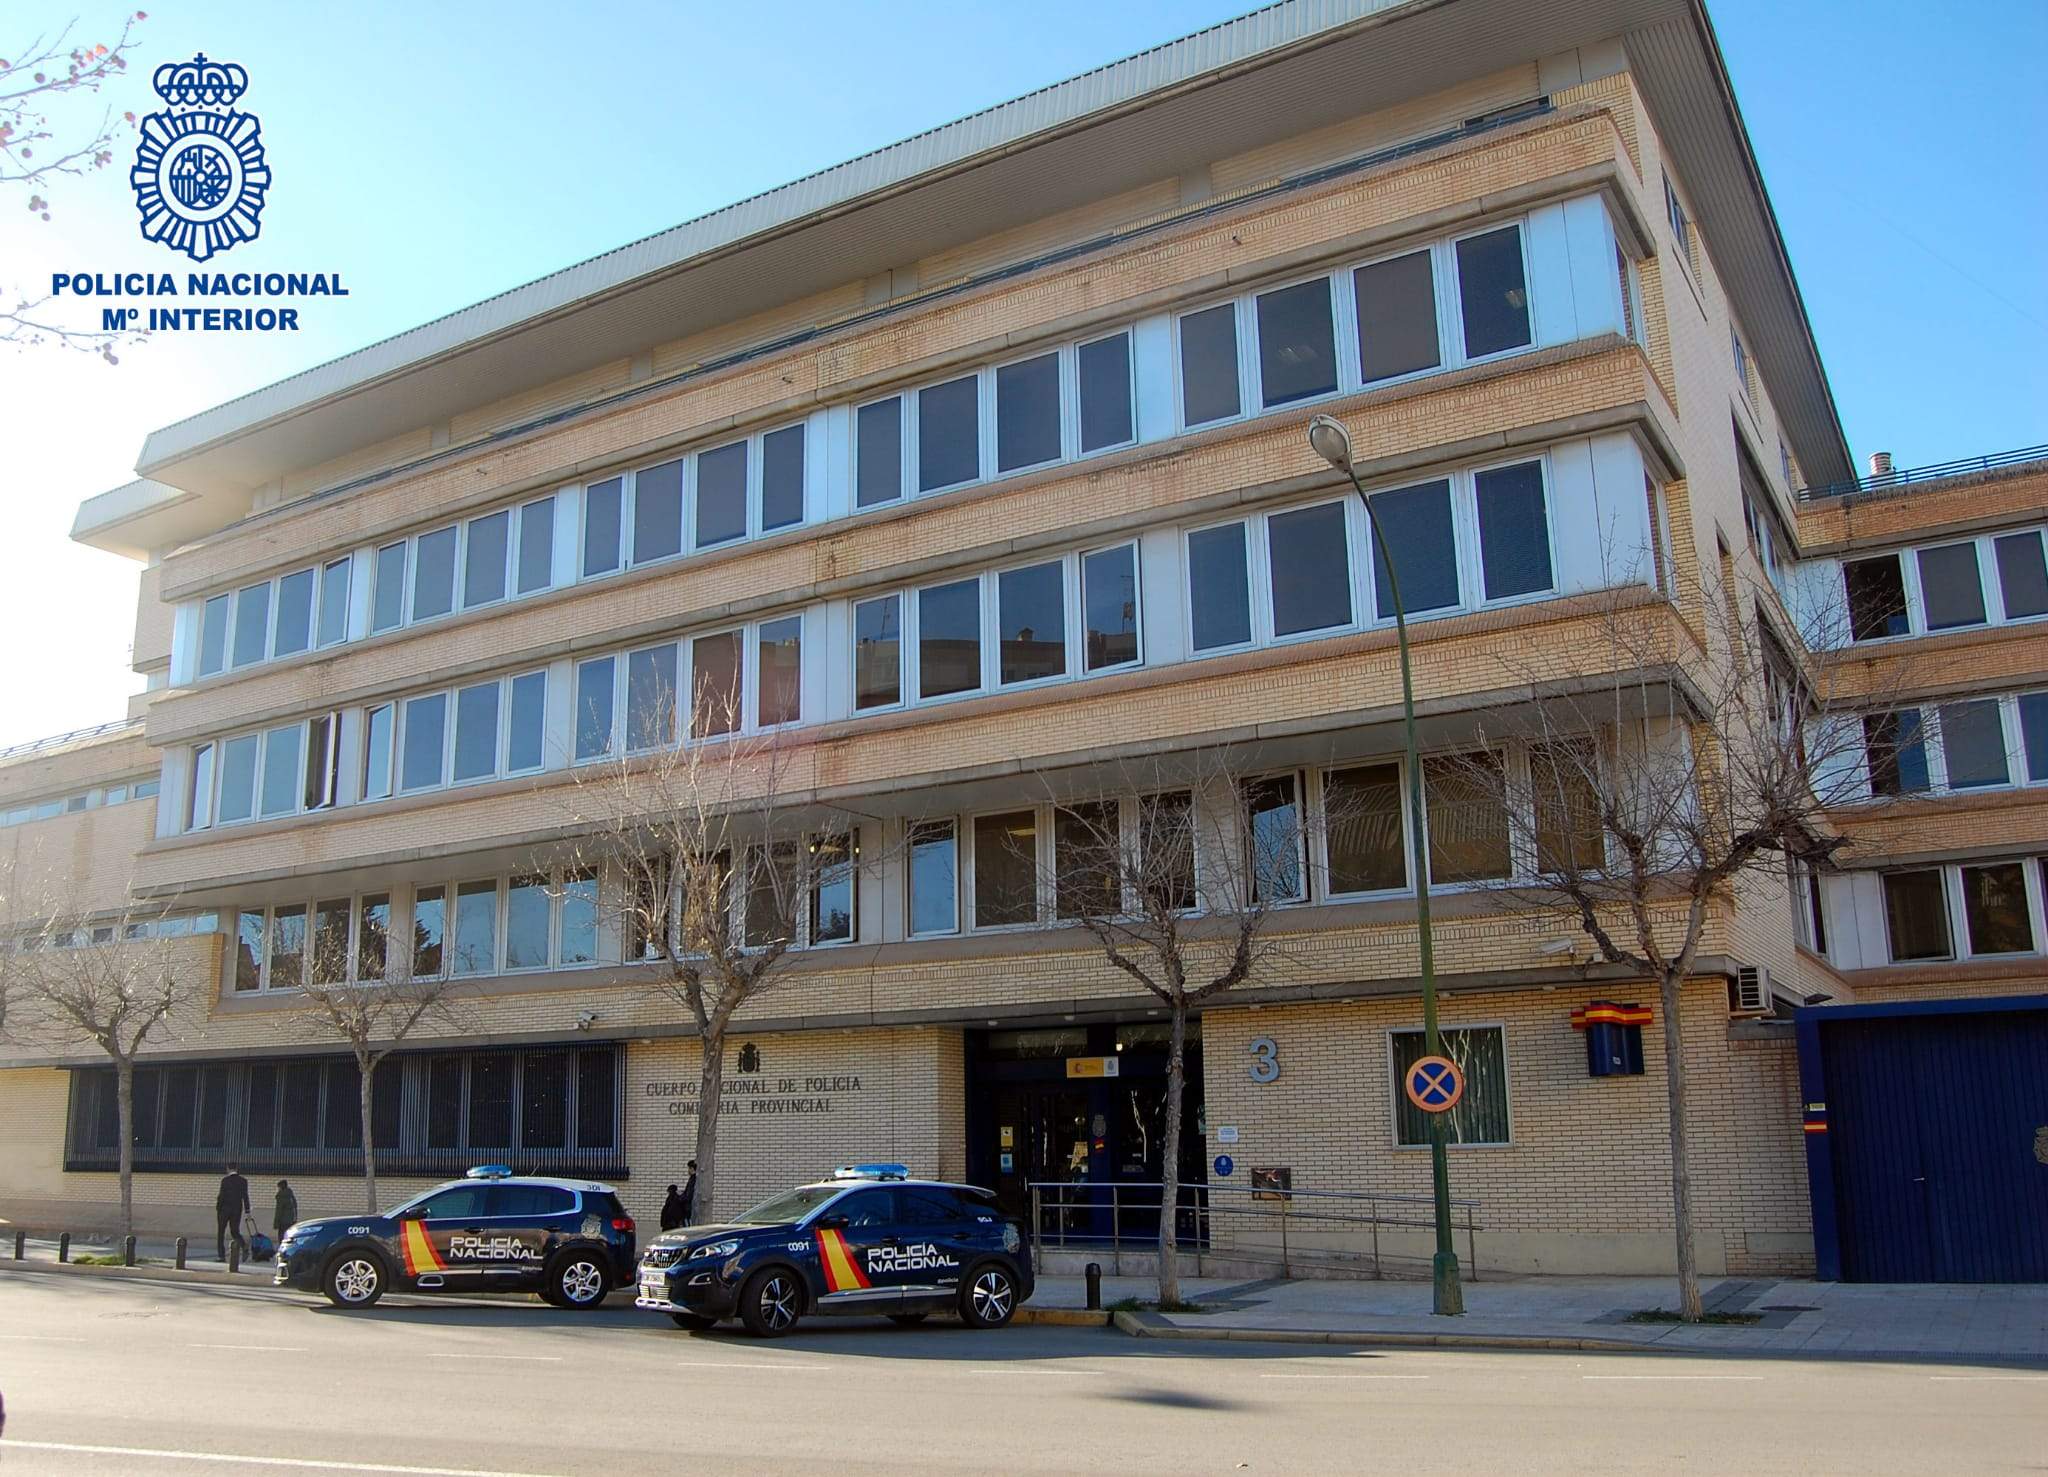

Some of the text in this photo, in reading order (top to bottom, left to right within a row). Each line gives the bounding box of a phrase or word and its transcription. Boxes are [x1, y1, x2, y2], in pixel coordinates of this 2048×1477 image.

[1248, 1038, 1280, 1084] 3
[646, 1076, 862, 1096] CUERPO CIONAL DE POLICIA
[669, 1099, 834, 1115] COMIRIA PROVINCIAL
[450, 1236, 523, 1249] POLICÍA
[867, 1241, 938, 1260] POLICÍA
[450, 1247, 544, 1260] NACIONAL
[868, 1255, 960, 1273] NACIONAL
